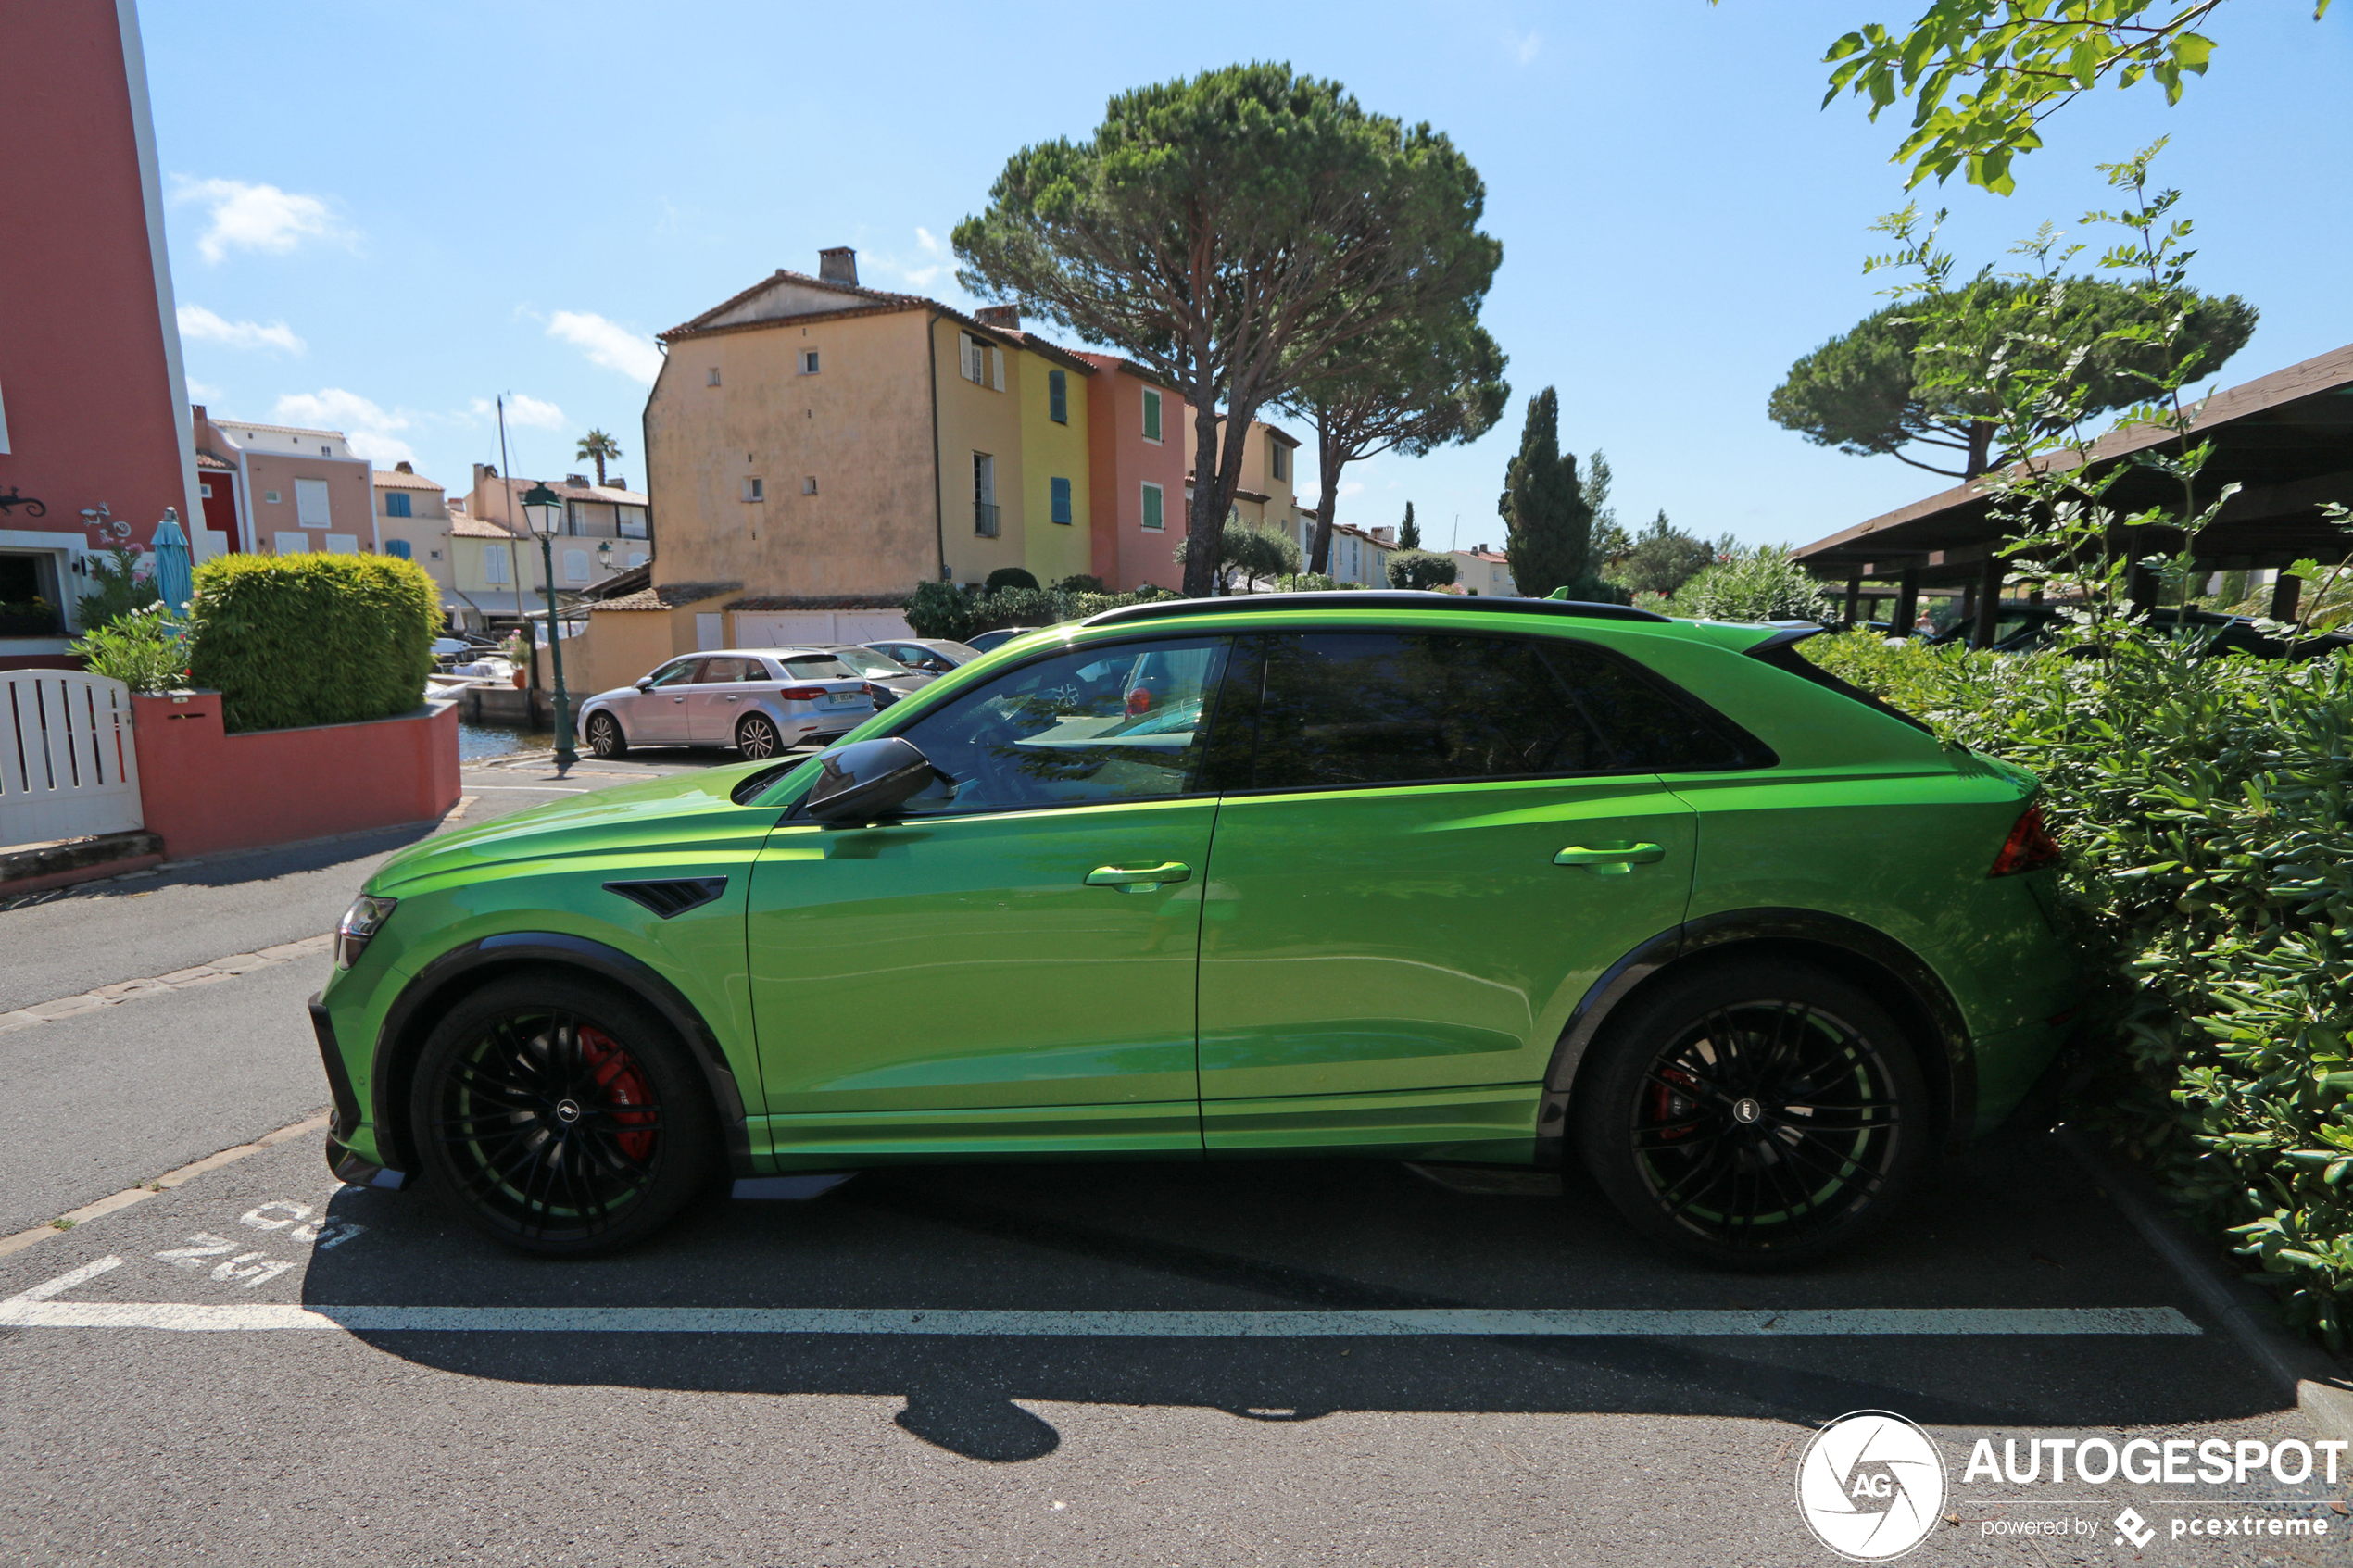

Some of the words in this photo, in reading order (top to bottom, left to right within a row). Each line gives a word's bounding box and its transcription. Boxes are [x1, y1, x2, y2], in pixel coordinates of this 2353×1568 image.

[707, 879, 724, 888] ABT
[617, 1089, 629, 1105] RS
[1743, 1101, 1752, 1121] ABT
